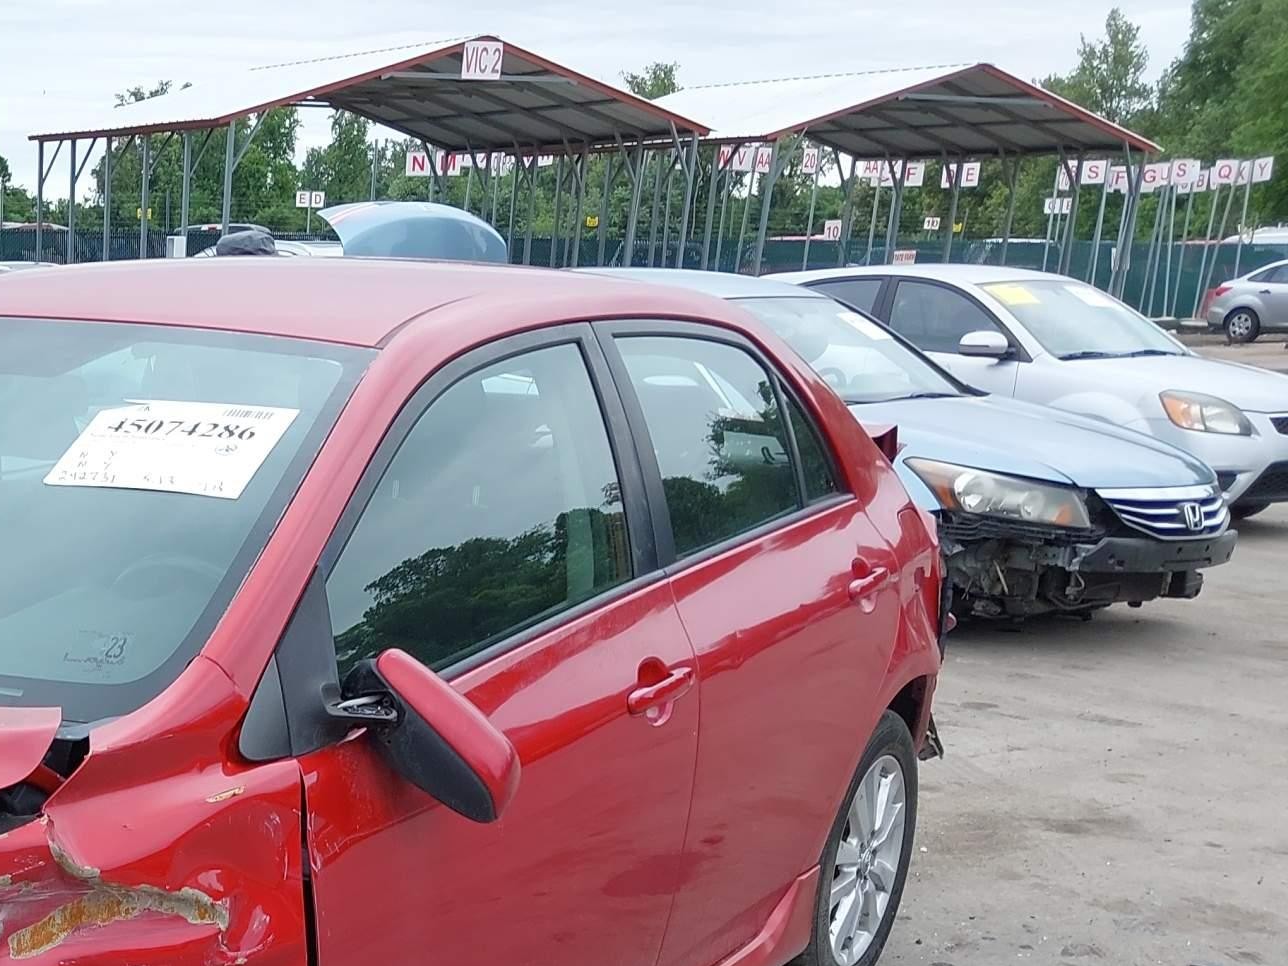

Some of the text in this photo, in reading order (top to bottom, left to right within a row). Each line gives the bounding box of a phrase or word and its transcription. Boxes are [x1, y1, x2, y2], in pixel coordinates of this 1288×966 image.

[466, 46, 501, 73] VIC 2
[412, 155, 425, 171] N
[738, 151, 748, 166] V
[804, 153, 816, 168] 20
[906, 167, 918, 181] F
[965, 167, 975, 182] E
[1087, 165, 1100, 179] S
[1143, 169, 1156, 183] G
[1176, 162, 1187, 177] S
[1218, 164, 1232, 179] Q
[1259, 160, 1269, 177] Y
[1115, 170, 1126, 185] F
[299, 193, 306, 204] E
[314, 193, 322, 204] D
[826, 225, 839, 240] 10
[107, 417, 256, 440] 45074286
